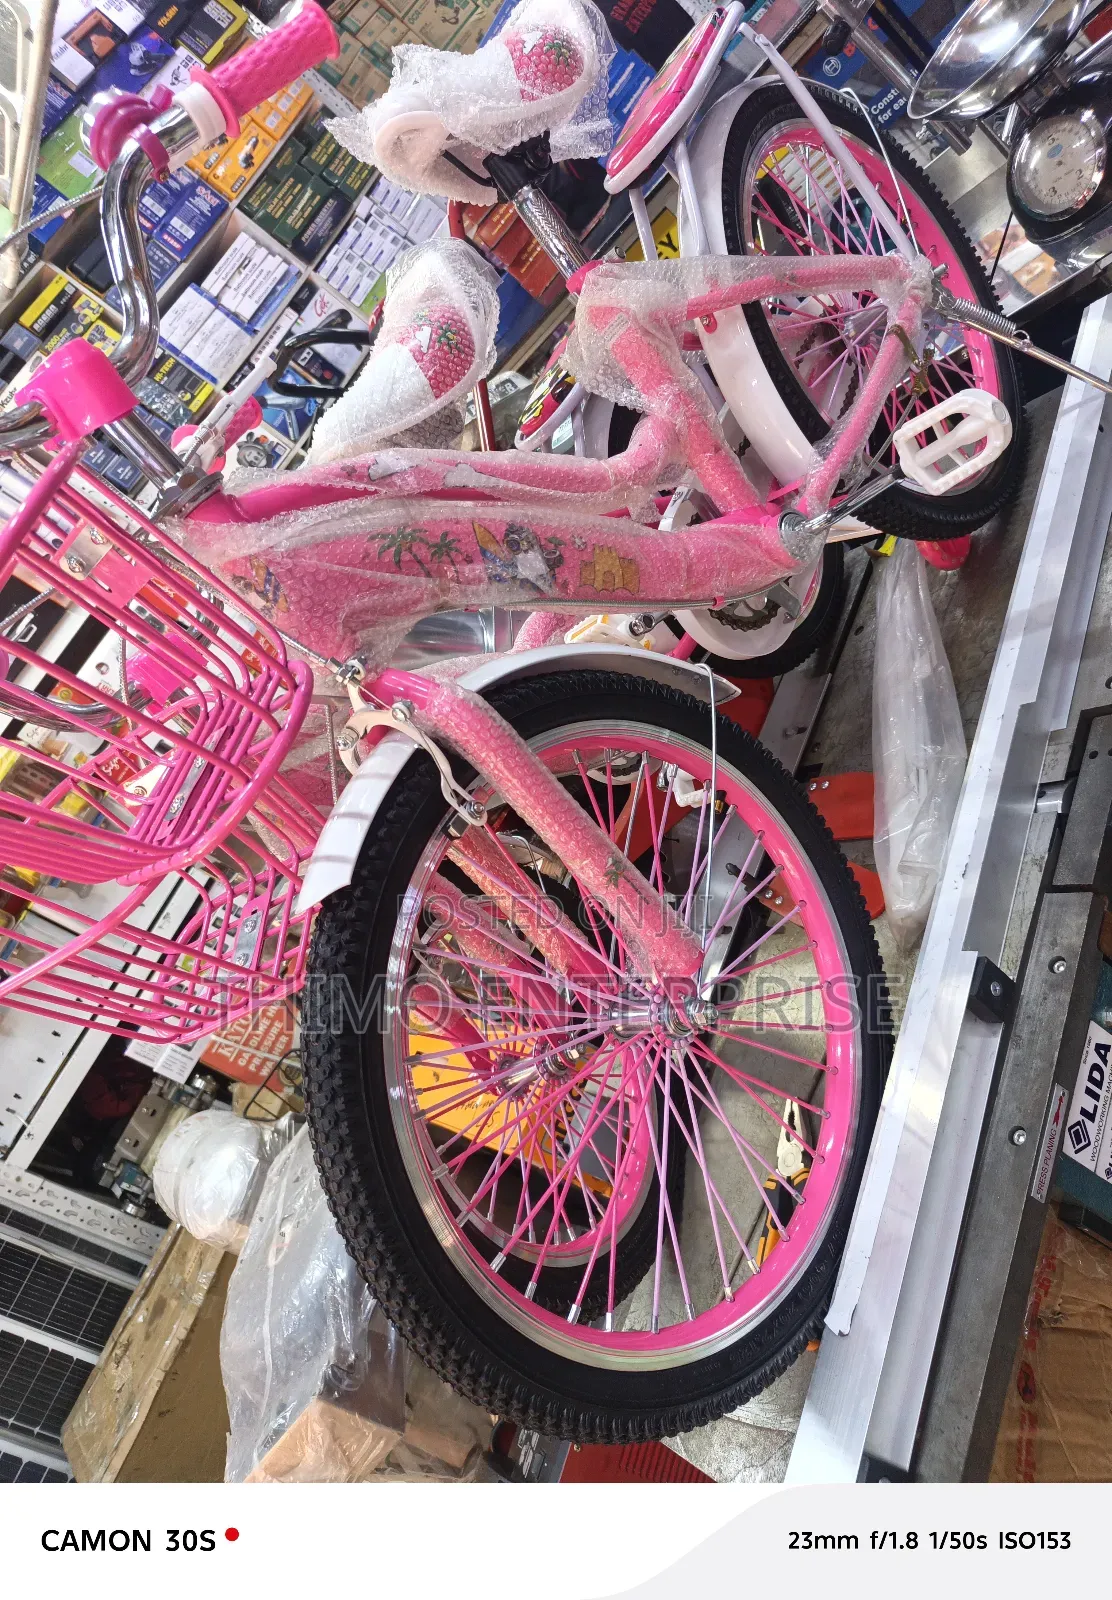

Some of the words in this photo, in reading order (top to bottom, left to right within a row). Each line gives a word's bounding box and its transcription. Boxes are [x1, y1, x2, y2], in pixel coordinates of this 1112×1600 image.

[876, 108, 893, 124] for
[266, 195, 278, 213] SOLAR
[301, 220, 318, 242] POWER
[314, 198, 334, 224] INVERTER
[44, 334, 61, 352] 2000
[154, 357, 176, 382] HI-TECH
[237, 1016, 272, 1068] GAOLINE
[248, 1019, 284, 1072] PRSSURE
[259, 1034, 289, 1078] WAHER
[1080, 1041, 1112, 1123] LIDA
[1043, 1128, 1057, 1161] PLANING
[1090, 1094, 1110, 1163] WOODWORKING
[1037, 1158, 1050, 1196] PRESS
